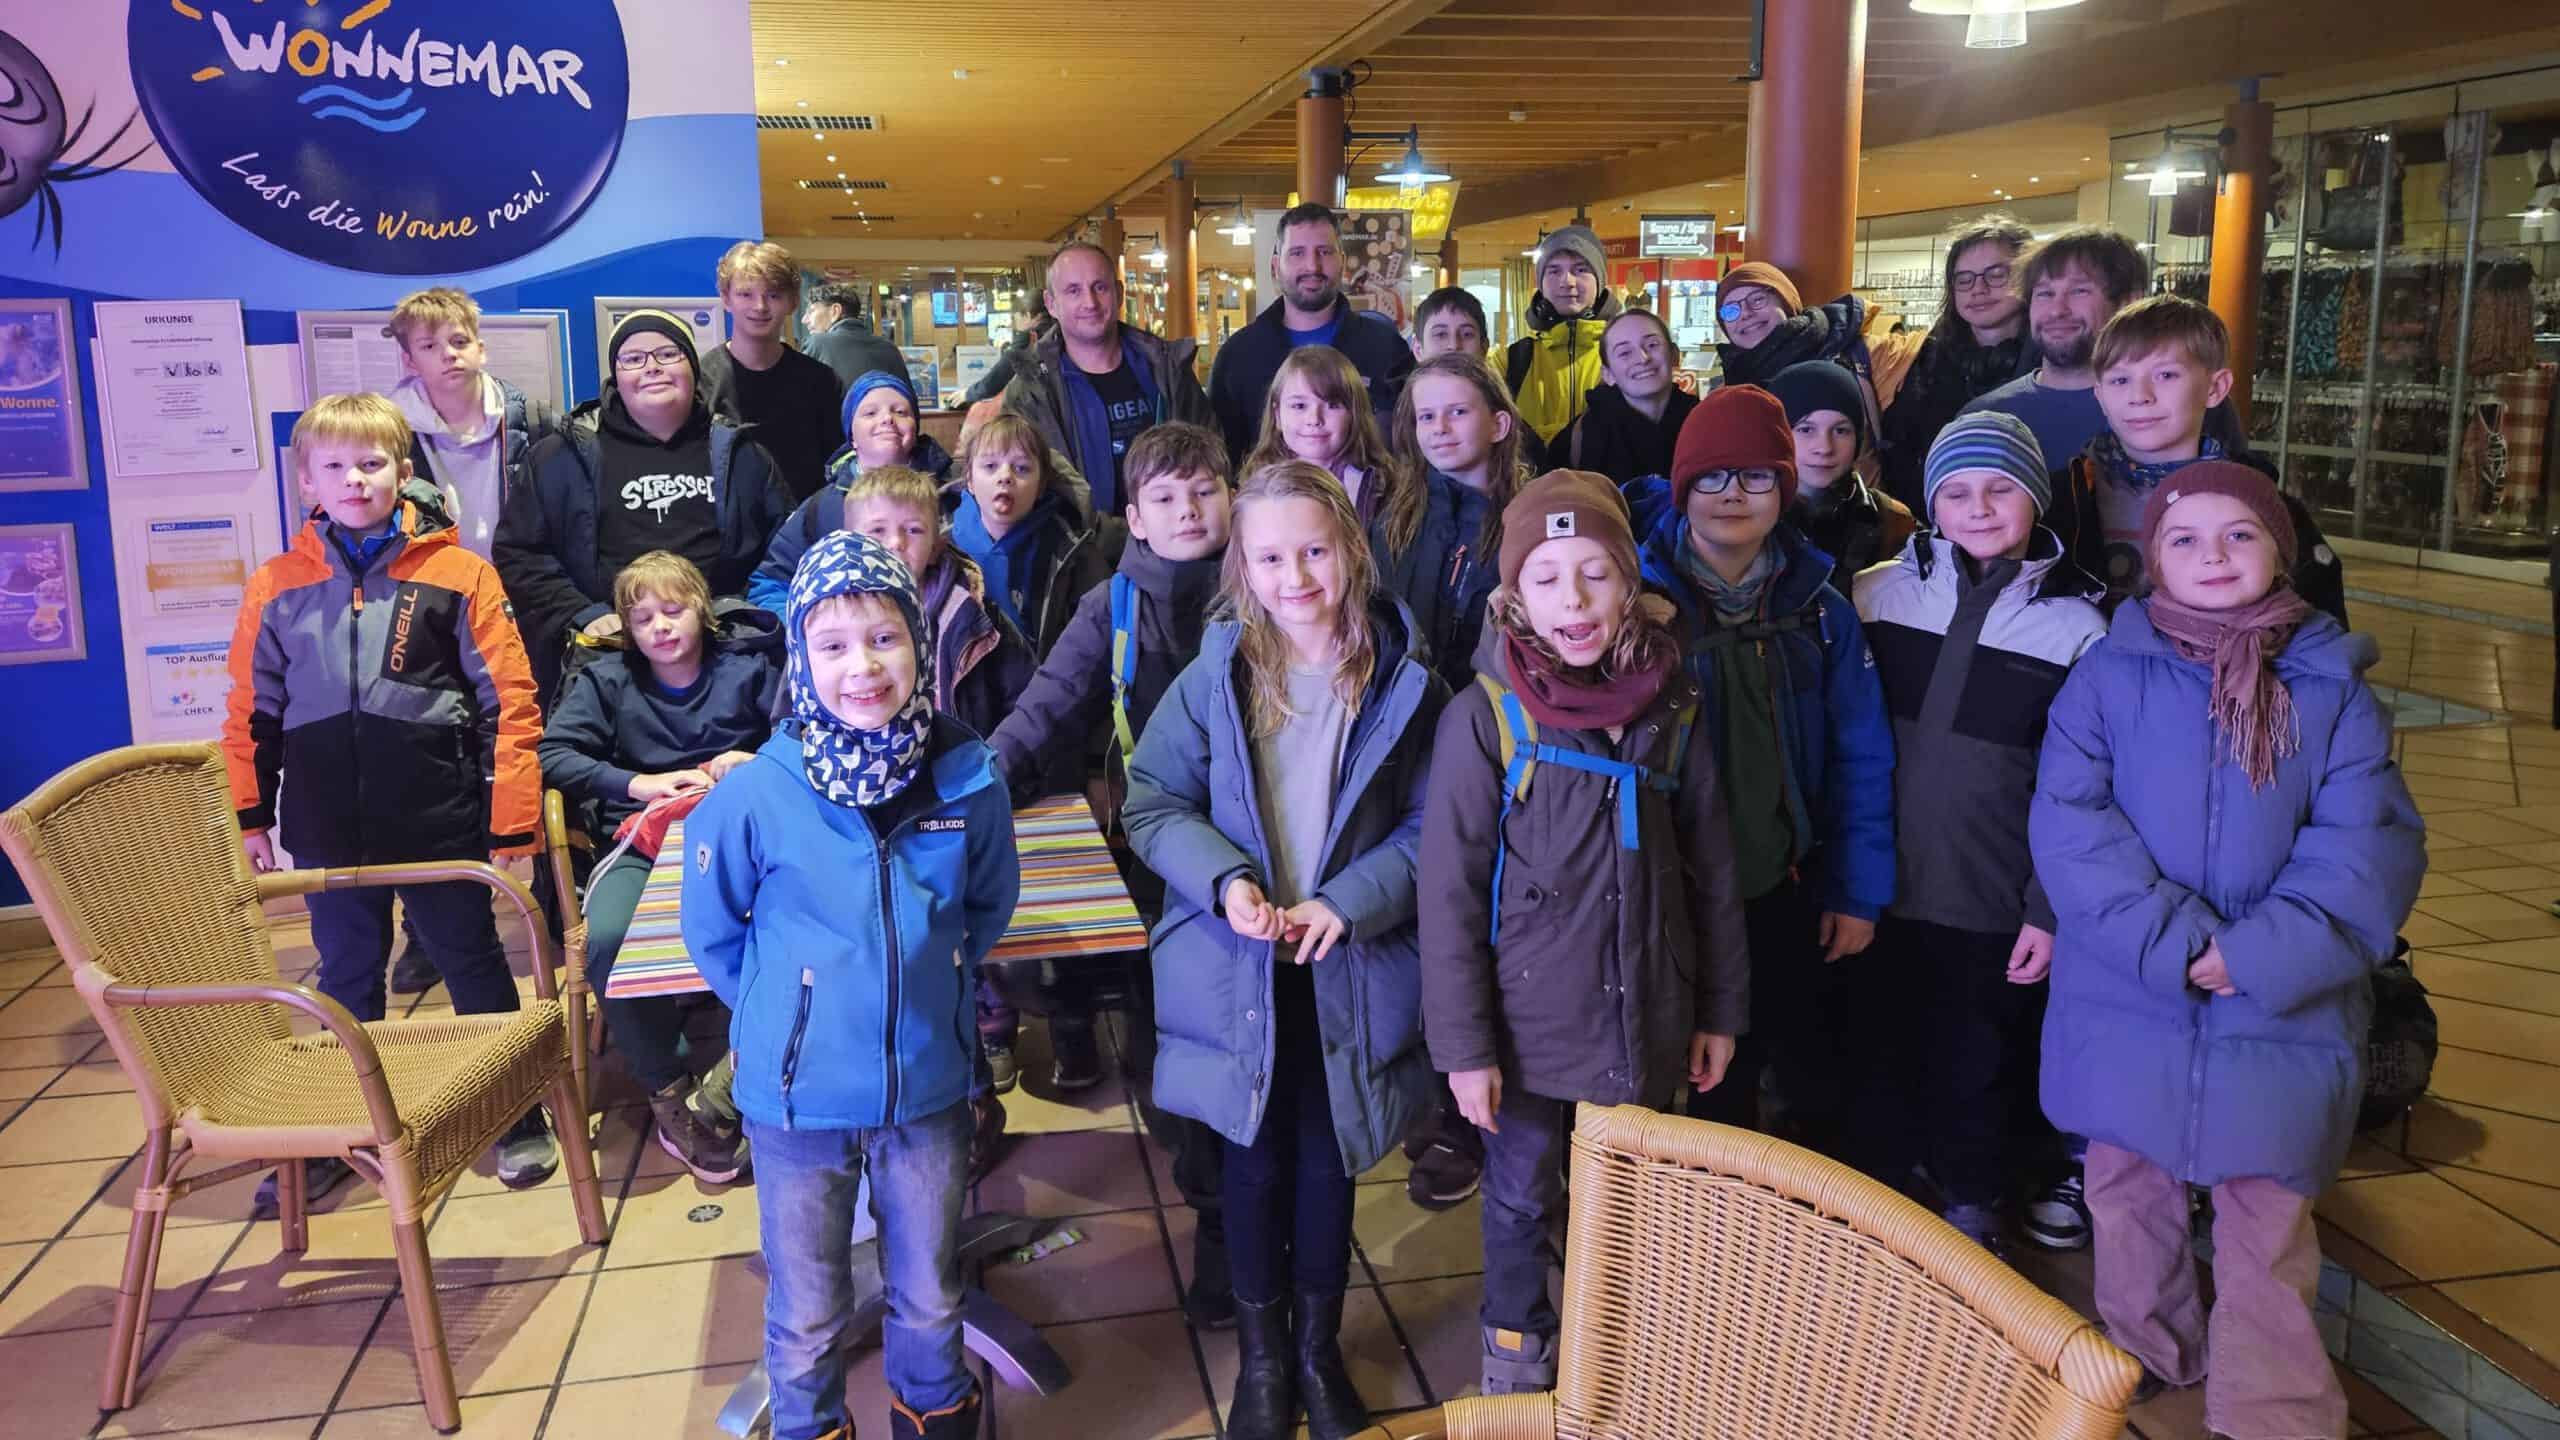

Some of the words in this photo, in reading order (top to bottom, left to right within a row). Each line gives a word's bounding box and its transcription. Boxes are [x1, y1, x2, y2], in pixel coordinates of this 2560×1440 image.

[212, 11, 592, 109] WONNEMAR
[222, 152, 300, 209] Lass
[308, 200, 365, 234] die
[376, 211, 479, 240] Wonne
[488, 169, 551, 229] rein!
[145, 315, 193, 324] URKUNDE
[165, 656, 186, 664] TOP
[184, 706, 214, 716] CHECK
